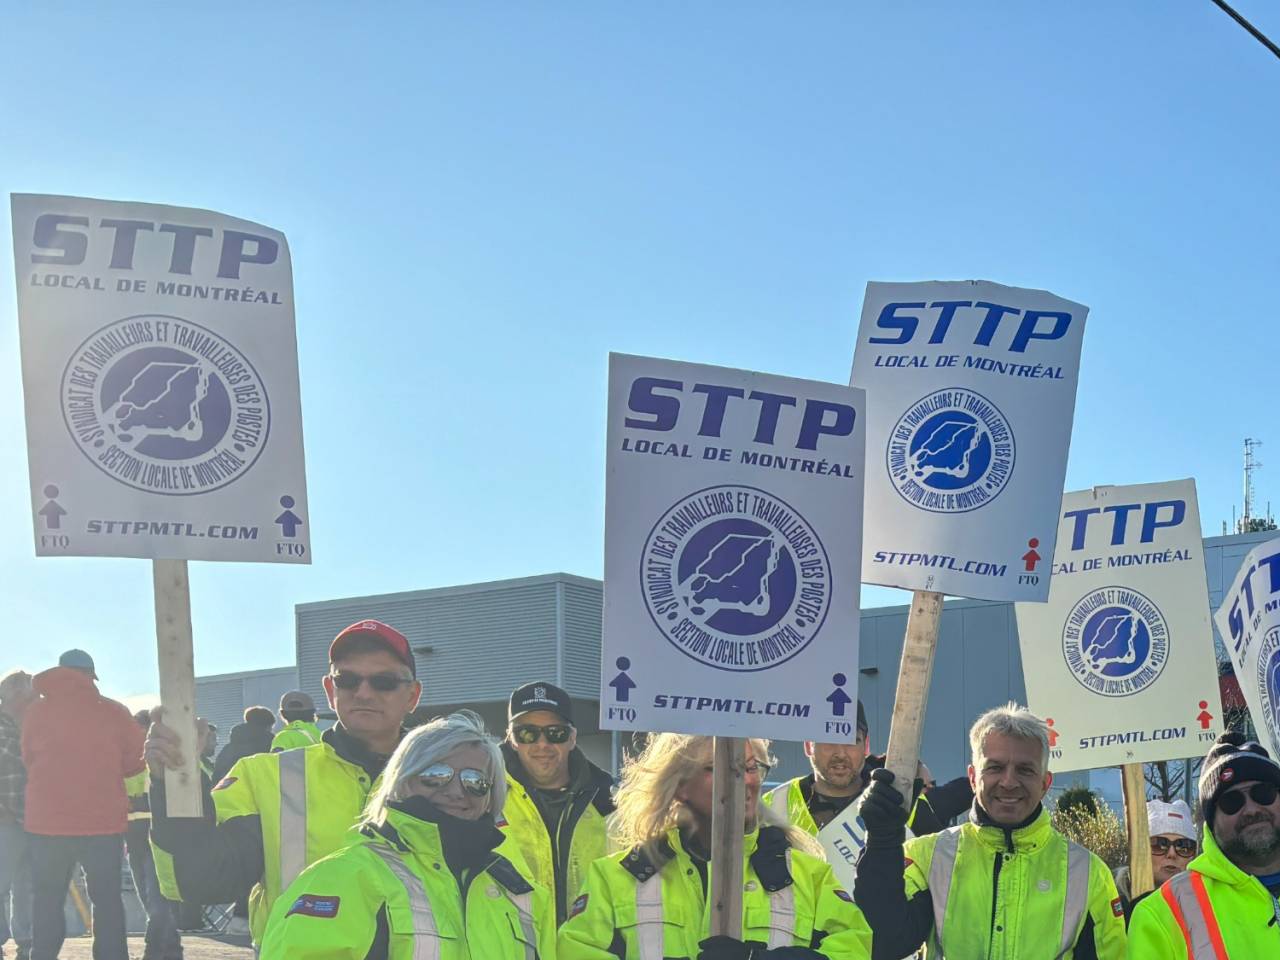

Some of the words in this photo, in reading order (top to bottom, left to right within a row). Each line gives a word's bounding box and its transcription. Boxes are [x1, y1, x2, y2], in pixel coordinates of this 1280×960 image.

[31, 214, 279, 280] STTP
[30, 274, 104, 291] LOCAL
[117, 279, 146, 293] DE
[156, 282, 282, 304] MONTRÉAL
[157, 322, 169, 342] ET
[869, 301, 1072, 353] STTP
[79, 322, 154, 370] TRAVAILLEURS
[175, 324, 250, 385] TRAVAILLEUSES
[70, 367, 97, 388] DES
[874, 355, 929, 368] LOCAL
[935, 355, 959, 367] DE
[964, 356, 1064, 379] MONTRÉAL
[233, 384, 260, 403] DES
[68, 388, 104, 441] SYNDICAT
[624, 376, 856, 450] STTP
[231, 407, 262, 447] POSTES
[98, 445, 143, 481] SECTION
[141, 463, 180, 489] LOCALE
[180, 467, 195, 489] DE
[193, 449, 244, 487] MONTRÉAL
[621, 438, 692, 458] LOCAL
[702, 447, 732, 462] DE
[740, 450, 854, 478] MONTRÉAL
[737, 492, 749, 513] ET
[662, 492, 733, 540] TRAVAILLEURS
[752, 496, 817, 559] TRAVAILLEUSES
[1064, 500, 1185, 550] TTP
[41, 535, 69, 549] FTQ
[87, 520, 258, 540] STTPMTL.COM
[276, 543, 305, 557] FTQ
[651, 536, 677, 559] DES
[1083, 558, 1103, 571] DE
[1108, 548, 1193, 569] MONTRÉAL
[800, 559, 824, 578] DES
[873, 551, 1007, 576] STTPMTL.COM
[648, 558, 678, 614] SYNDICAT
[1018, 575, 1039, 585] FTQ
[795, 582, 824, 623] POSTES
[671, 618, 712, 656] SECTION
[709, 638, 744, 664] LOCALE
[746, 642, 758, 665] DE
[757, 624, 804, 663] MONTRÉAL
[608, 707, 636, 722] FTQ
[653, 694, 810, 718] STTPMTL.COM
[825, 722, 851, 736] FTQ
[1079, 727, 1186, 749] STTPMTL.COM
[1050, 750, 1062, 759] TQ
[834, 839, 856, 866] LOC
